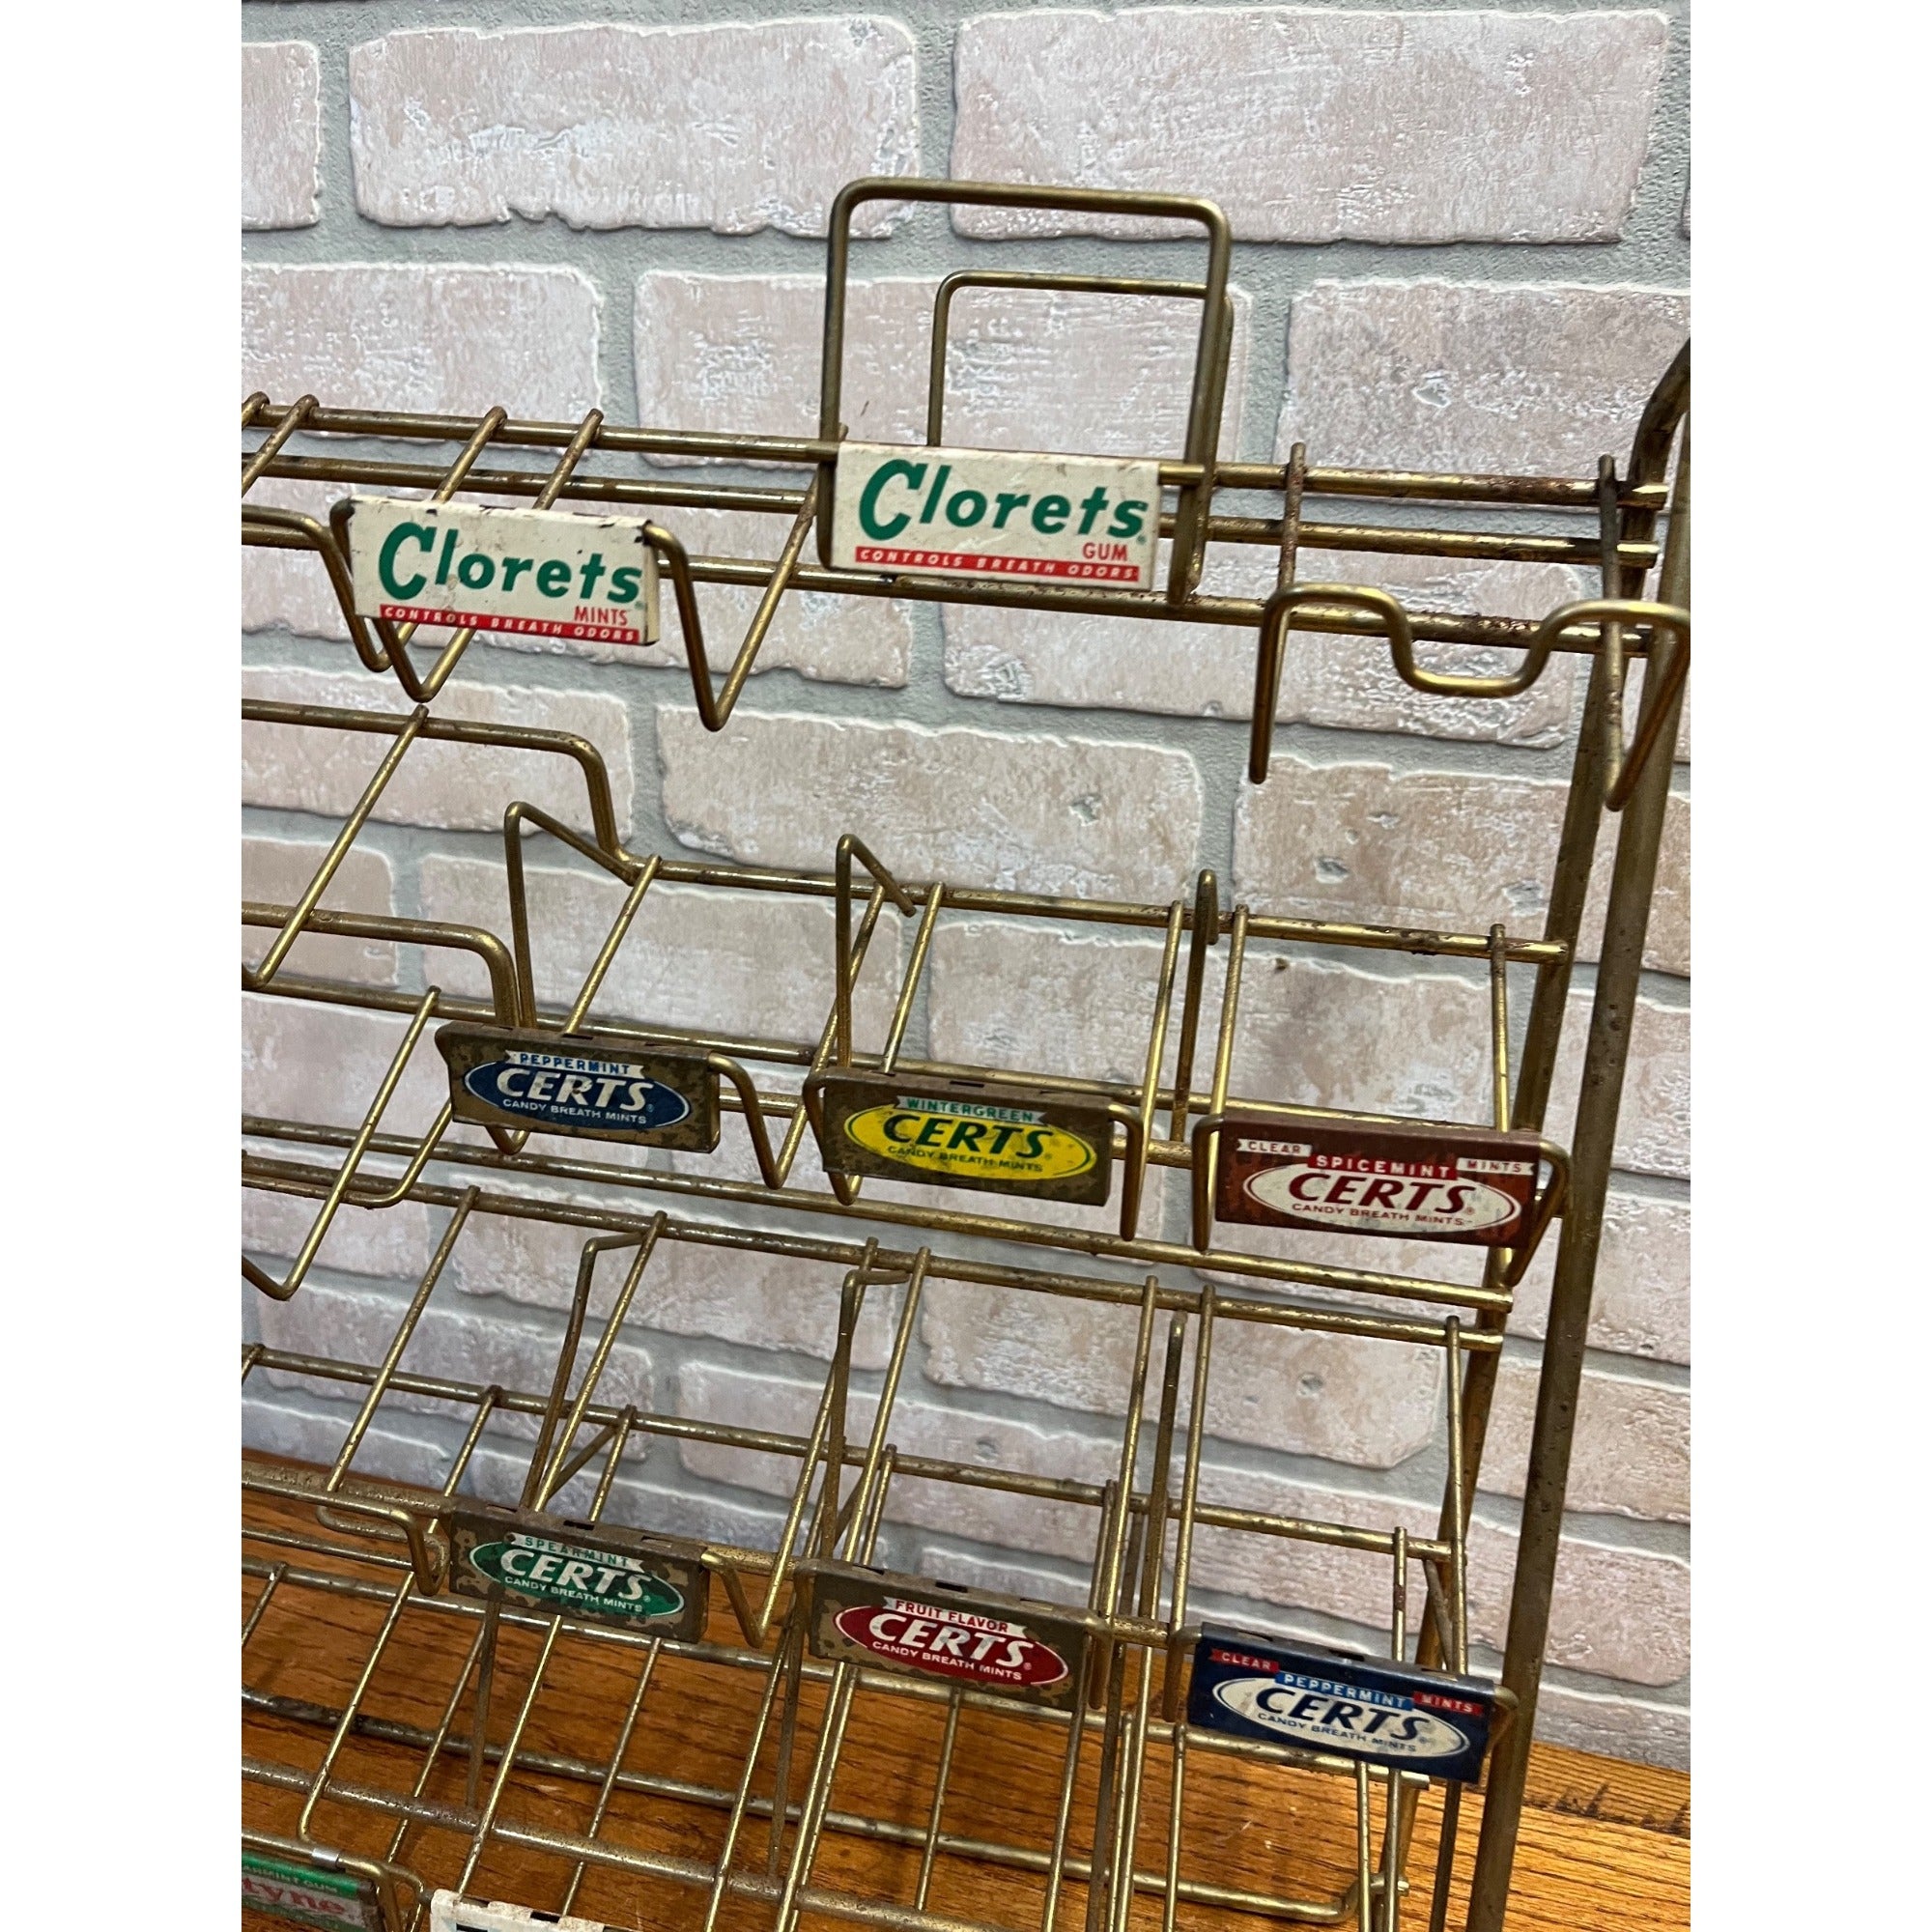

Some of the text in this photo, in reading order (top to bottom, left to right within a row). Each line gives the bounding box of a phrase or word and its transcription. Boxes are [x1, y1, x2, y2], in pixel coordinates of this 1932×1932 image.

[859, 458, 1149, 541] Clorets
[379, 522, 642, 603] Clorets
[860, 550, 1134, 579] CONTROLS BREATH ODORS
[1082, 542, 1128, 560] GUM
[384, 607, 635, 641] CONTROLS BREATH ODORS
[574, 607, 628, 626] MINTS
[520, 1053, 630, 1073] PEPPERMINT
[497, 1067, 654, 1111] CERTS
[503, 1098, 647, 1124] CANDY BREATH MINTS
[906, 1097, 1034, 1122] WINTERGREEN
[883, 1114, 1053, 1158] CERTS
[888, 1145, 1043, 1172] CANDY BREATH MINTS
[1248, 1141, 1522, 1179] CLEAR SPICEMINT MINTS
[1289, 1173, 1476, 1214] CERTS
[1292, 1203, 1463, 1226] CANDY BREATH MINTS
[525, 1536, 629, 1567] SPEARMINT
[500, 1548, 653, 1601] CERTS
[504, 1576, 642, 1612] CANDY BREATH MINTS
[895, 1600, 1009, 1633] FRUIT FLAVOR
[869, 1613, 1036, 1667] CERTS
[872, 1641, 1022, 1680] CANDY BREATH MINTS
[1221, 1652, 1473, 1713] CLEAR PEPPERMINT MINTS
[1256, 1688, 1430, 1741] CERTS
[1258, 1713, 1416, 1752] CANDY BREATH MINTS
